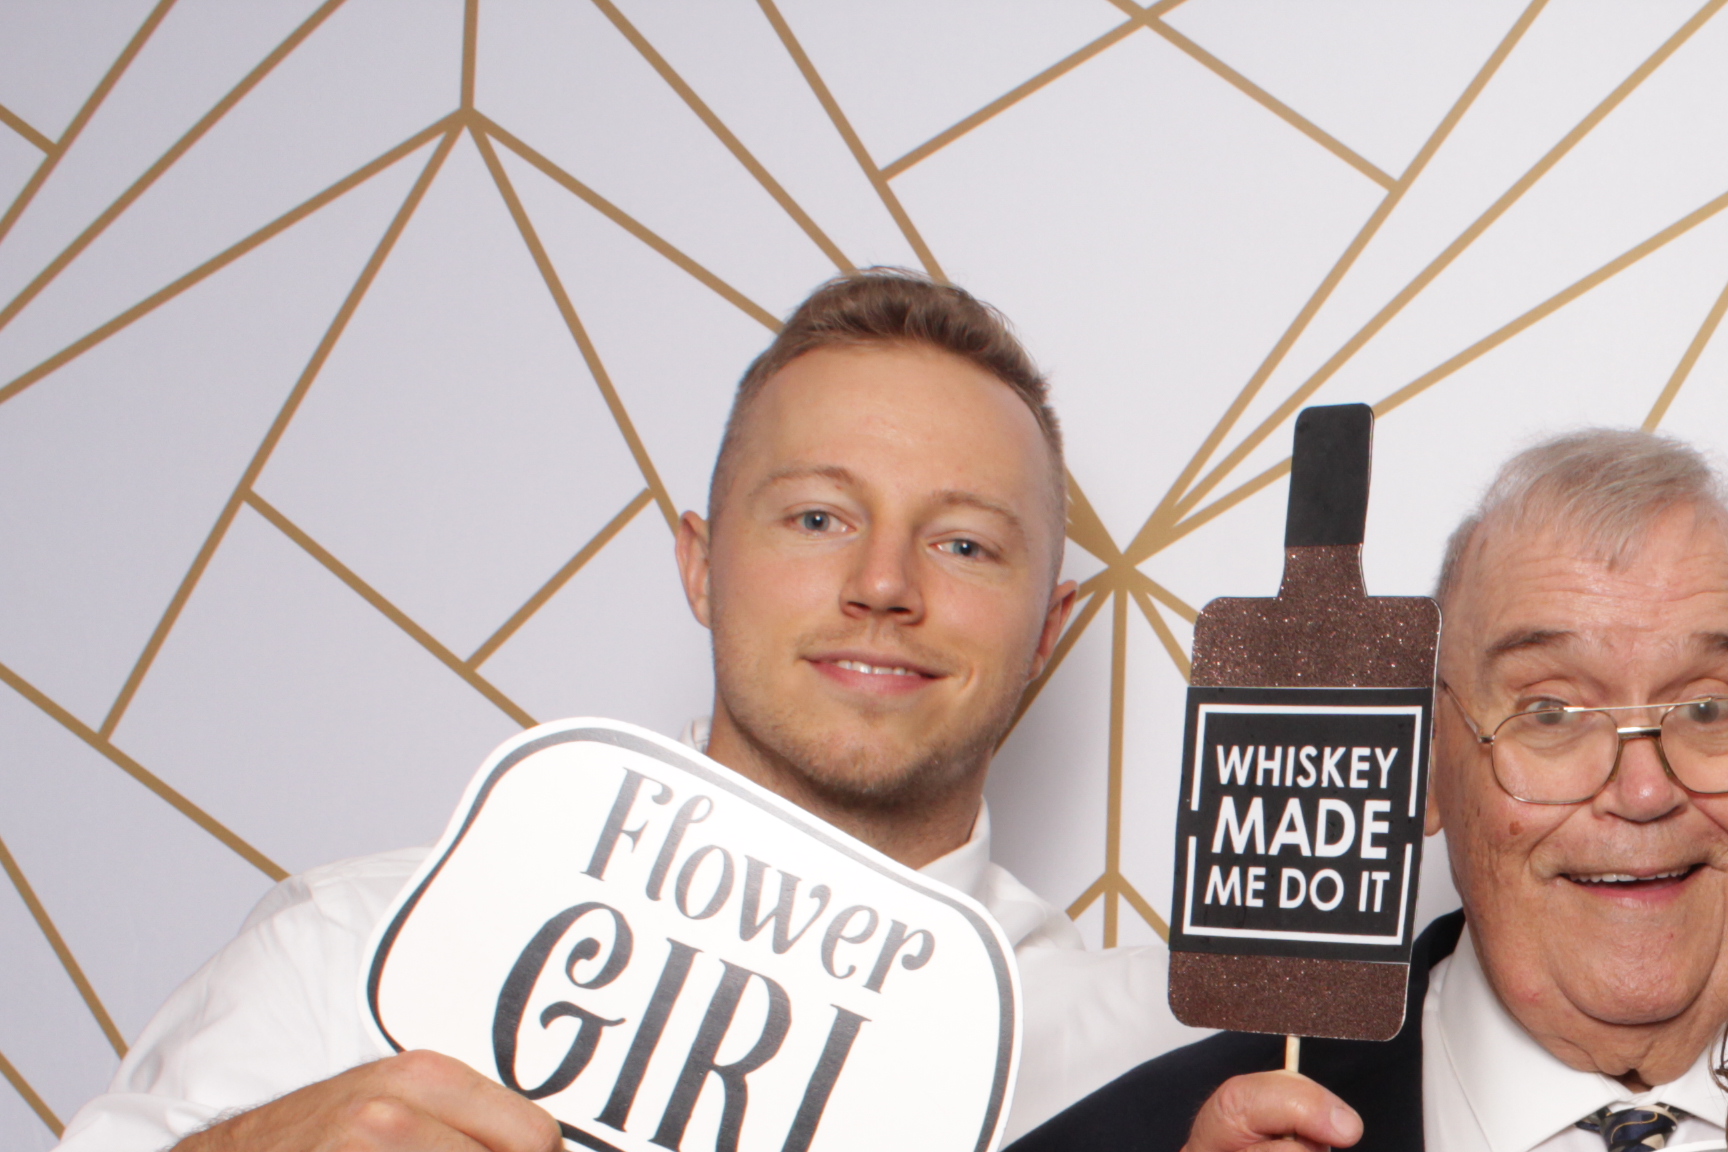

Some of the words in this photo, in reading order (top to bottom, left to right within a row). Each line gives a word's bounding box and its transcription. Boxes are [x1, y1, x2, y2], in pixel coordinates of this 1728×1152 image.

[1216, 744, 1399, 789] WHISKEY
[1211, 795, 1391, 860] MADE
[579, 766, 936, 995] Flower
[1204, 865, 1267, 908] ME
[1278, 867, 1344, 912] DO
[1358, 870, 1391, 913] IT
